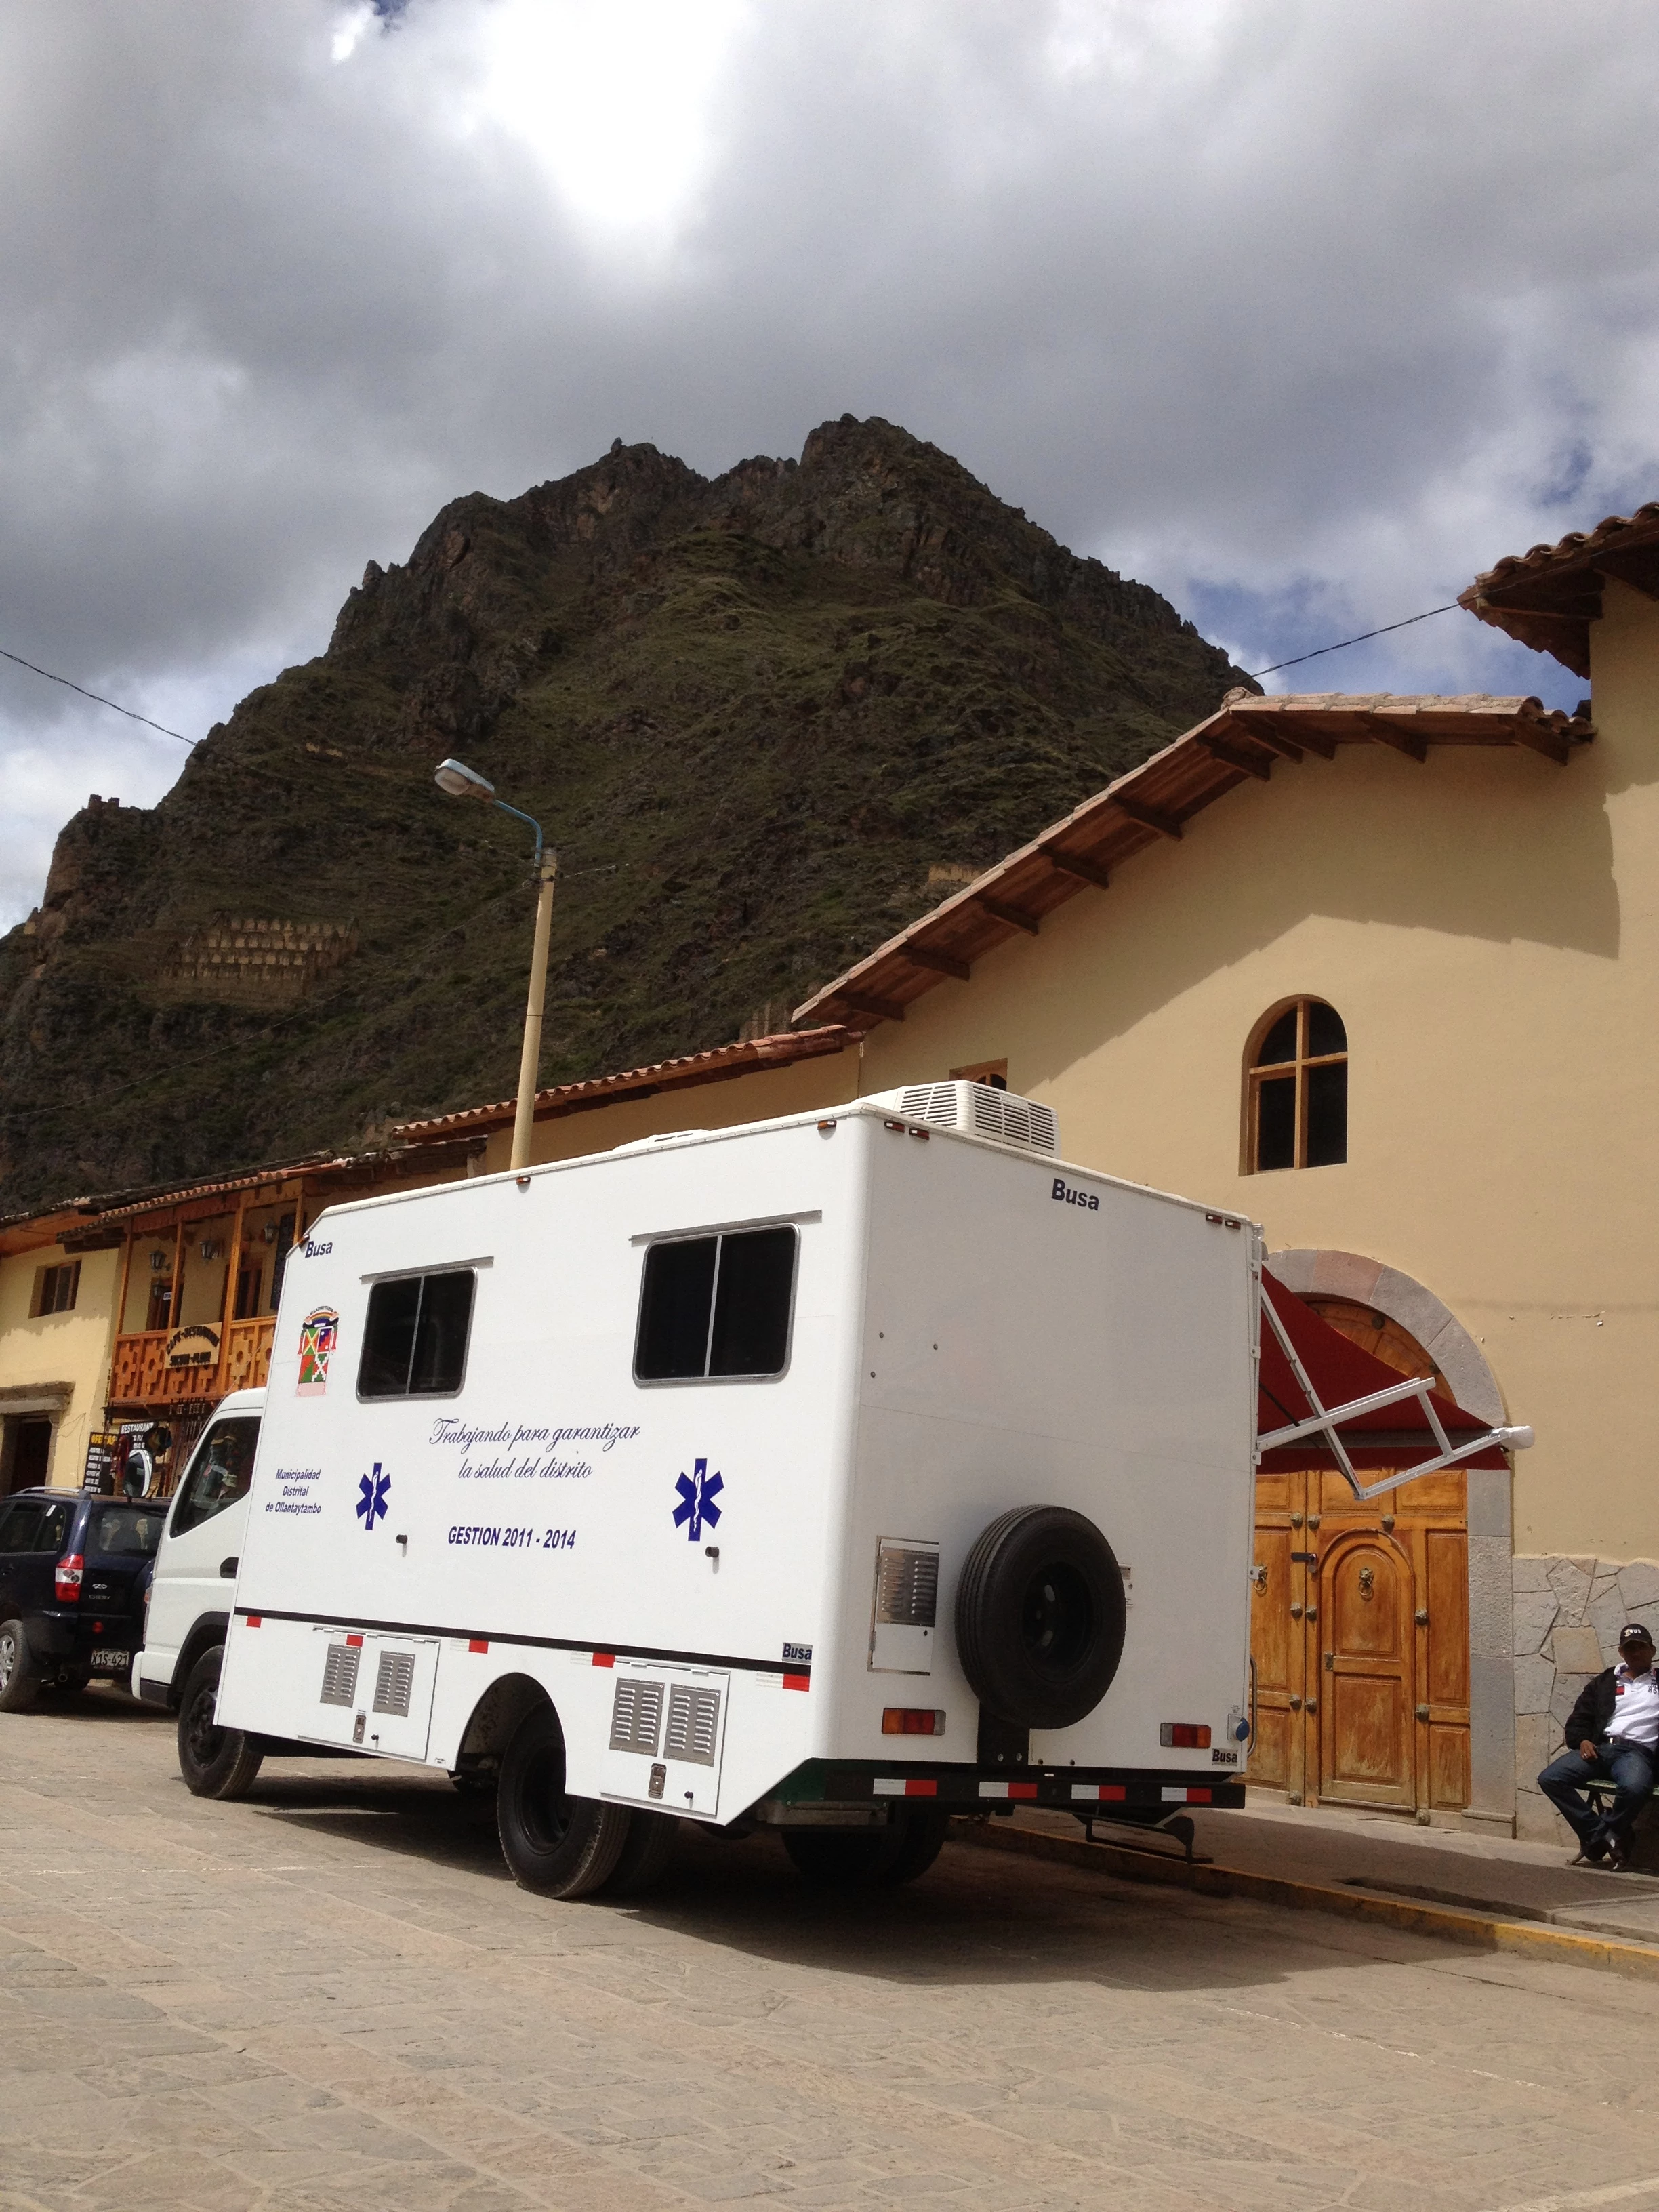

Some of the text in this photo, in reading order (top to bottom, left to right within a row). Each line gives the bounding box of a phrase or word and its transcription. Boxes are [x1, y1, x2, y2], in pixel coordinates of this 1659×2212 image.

[1051, 1177, 1099, 1211] Busa
[305, 1240, 333, 1258] Busa
[429, 1418, 640, 1454] Trabajando para garantizar
[275, 1469, 322, 1483] Municipalidad
[458, 1457, 593, 1479] la salud del distrito
[282, 1485, 310, 1497] Distrital
[265, 1501, 322, 1516] de Ollantaytambo
[447, 1525, 501, 1546] GESTION
[501, 1527, 534, 1548] 2011
[542, 1528, 577, 1550] 2014
[91, 1652, 127, 1667] X1S-421
[782, 1643, 813, 1660] Busa
[1212, 1748, 1237, 1763] Busa
